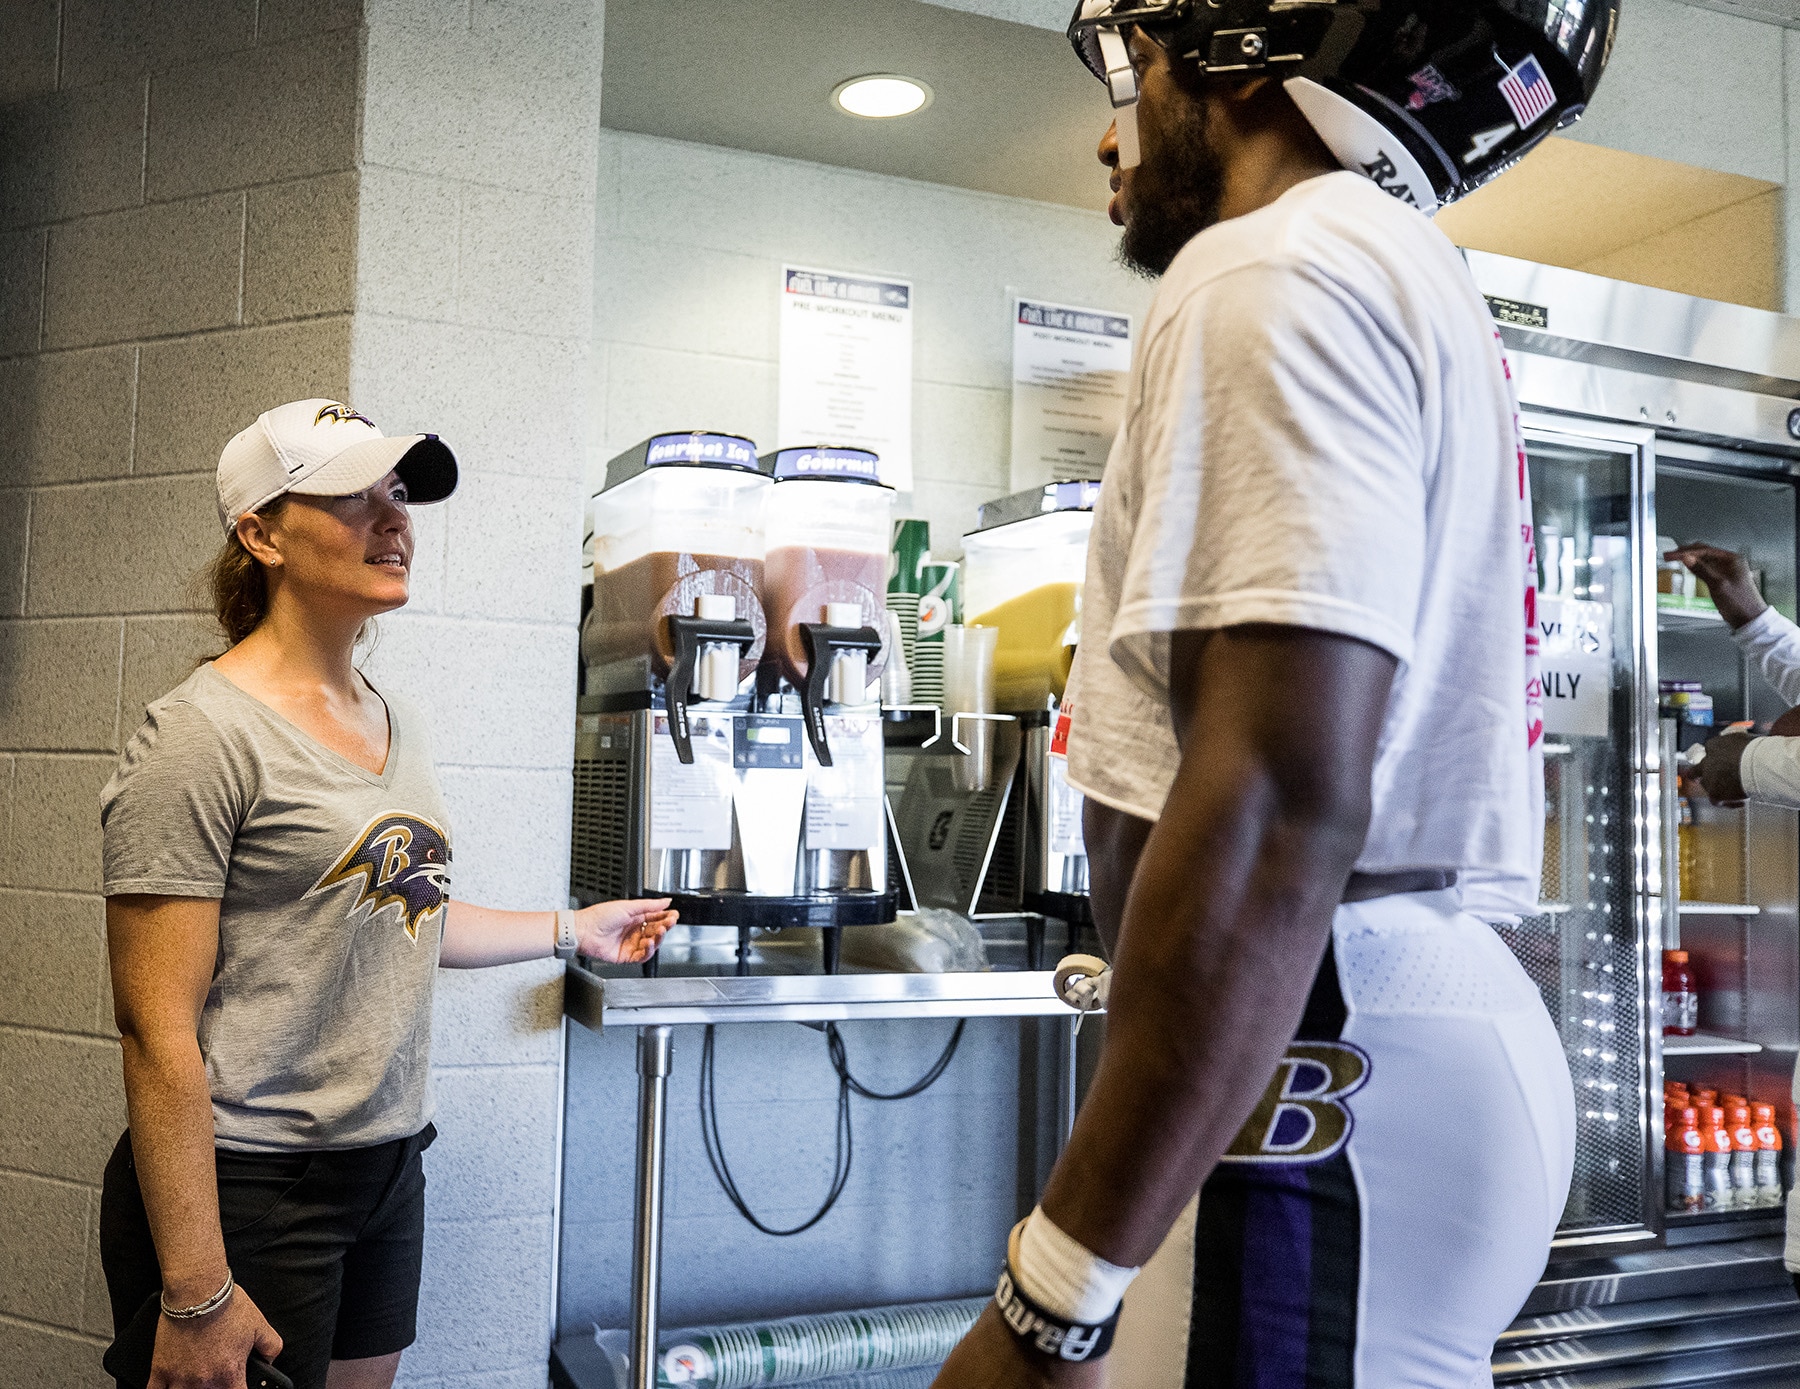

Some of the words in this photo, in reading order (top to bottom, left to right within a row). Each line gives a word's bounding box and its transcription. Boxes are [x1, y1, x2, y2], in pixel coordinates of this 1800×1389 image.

[1462, 122, 1518, 165] 4
[369, 825, 413, 887] B
[1220, 1038, 1372, 1164] B
[1735, 1127, 1753, 1147] G
[1757, 1126, 1775, 1146] G
